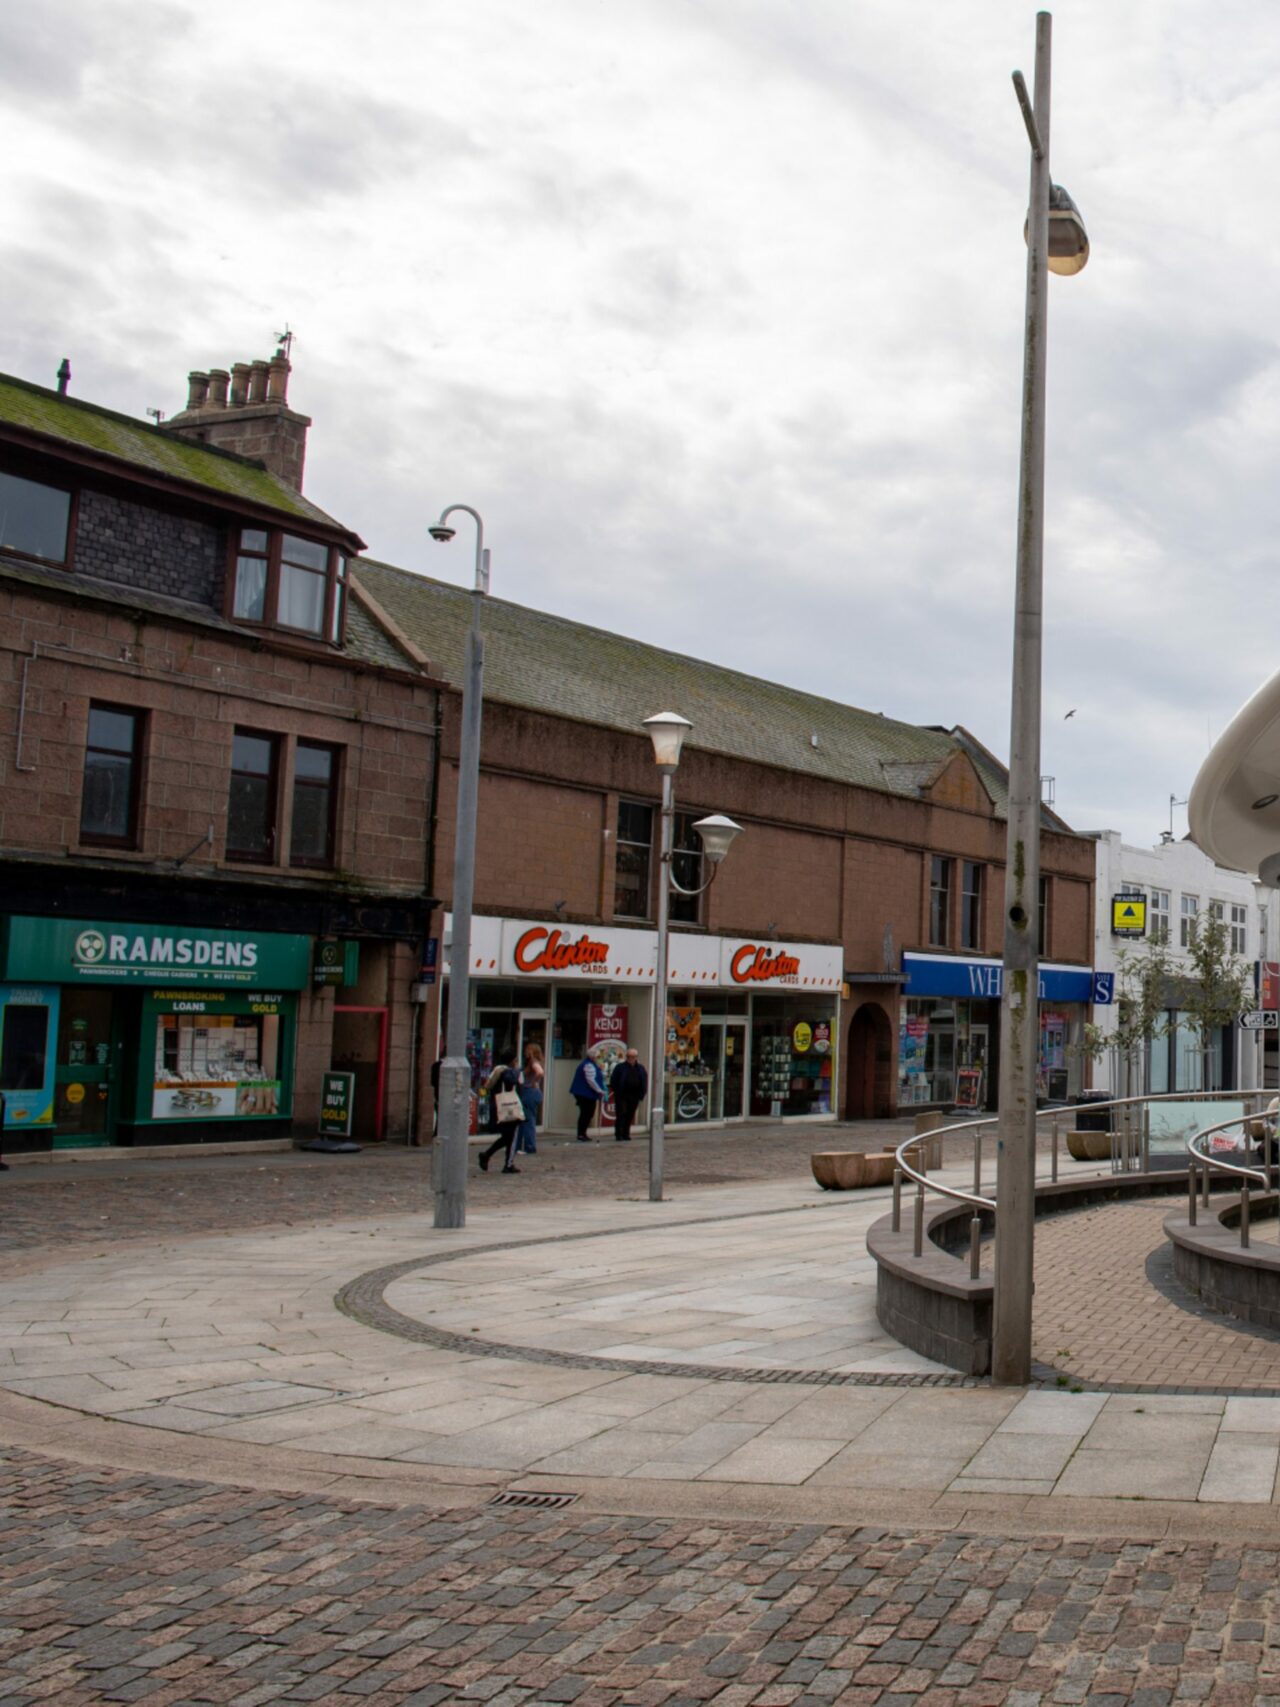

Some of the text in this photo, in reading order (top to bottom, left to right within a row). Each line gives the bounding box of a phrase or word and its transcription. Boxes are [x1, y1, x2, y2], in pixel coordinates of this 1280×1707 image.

[109, 935, 258, 967] RAMSDENS
[514, 926, 610, 973] Clinton
[581, 964, 609, 974] CARDS
[730, 944, 801, 983] Clinton
[153, 991, 226, 1001] PAWNBROKING
[1095, 981, 1110, 1003] S
[248, 994, 283, 1003] WE BUY
[172, 1002, 206, 1011] LOANS
[252, 1003, 277, 1012] GOLD
[330, 1080, 344, 1091] WE
[326, 1094, 345, 1106] BUY
[322, 1109, 347, 1121] GOLD
